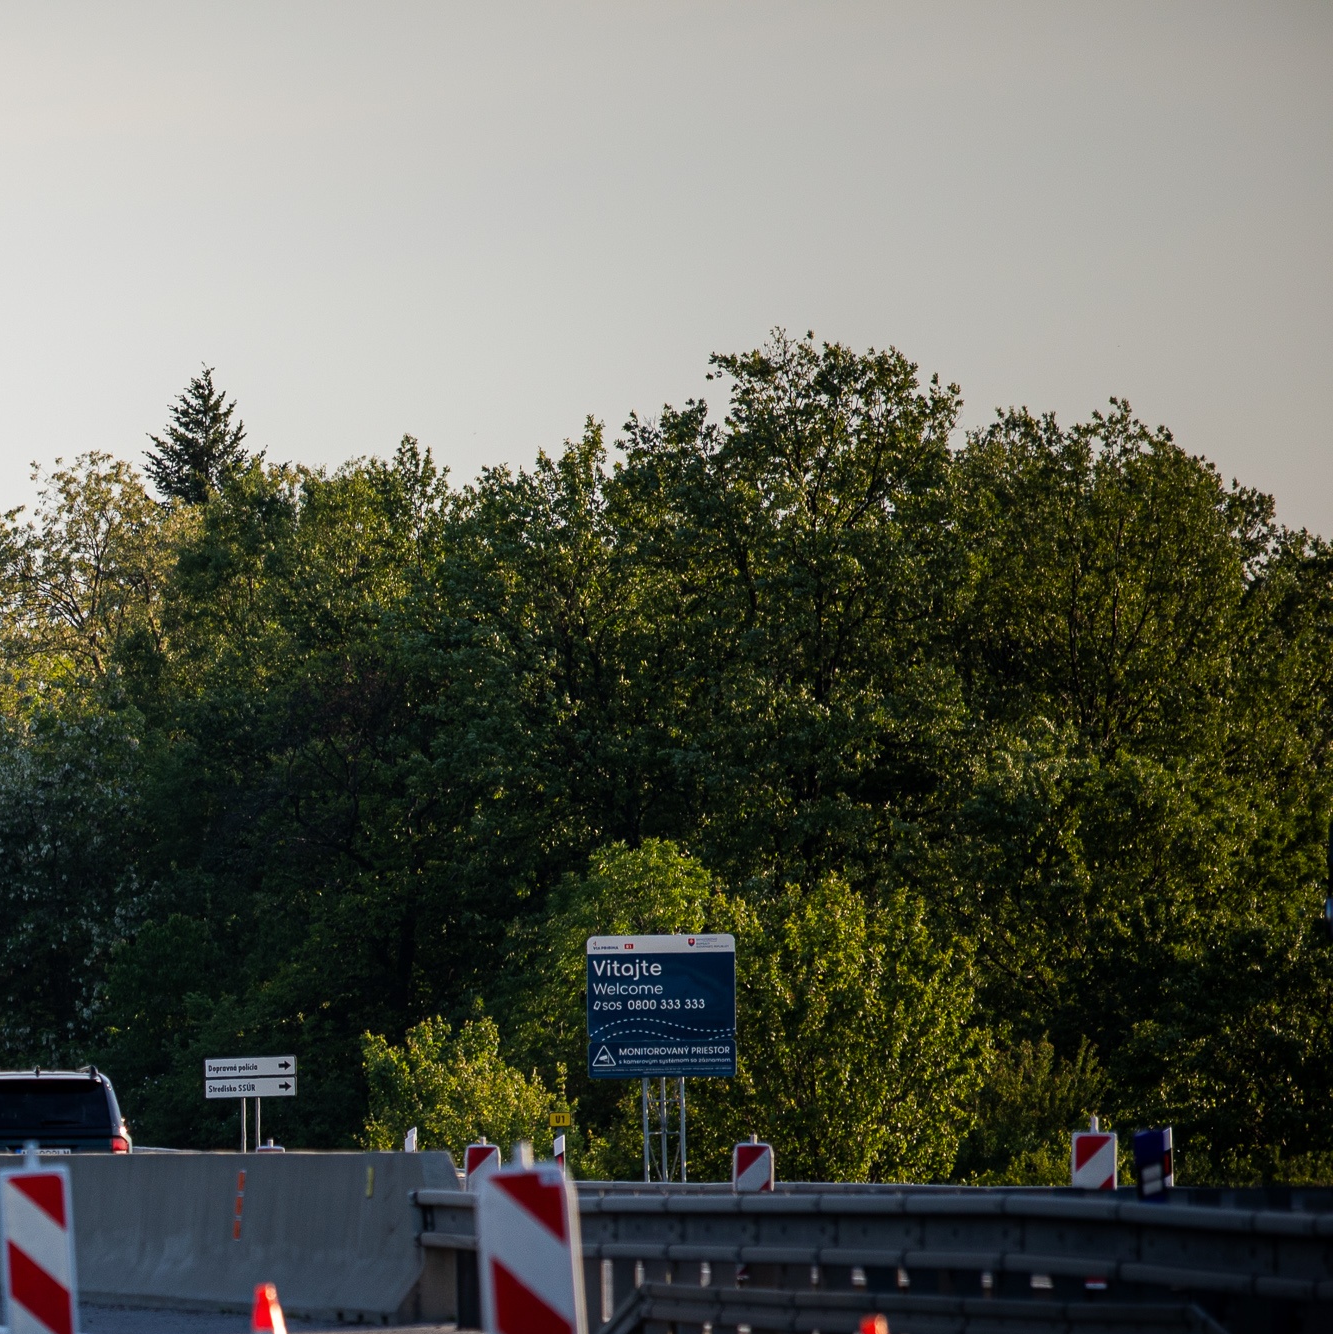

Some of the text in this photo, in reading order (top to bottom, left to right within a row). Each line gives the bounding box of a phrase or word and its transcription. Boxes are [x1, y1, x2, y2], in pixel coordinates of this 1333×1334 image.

[593, 959, 662, 980] Vitajte
[593, 982, 663, 995] Welcome
[627, 1000, 656, 1010] 0800
[660, 999, 681, 1009] 333
[684, 999, 705, 1009] 333
[619, 1046, 730, 1056] MONITOROVANÝ PRIESTOR
[208, 1063, 258, 1074] Dopravná polícia
[208, 1082, 256, 1093] Stredisko SSÚR
[555, 1115, 565, 1124] U1
